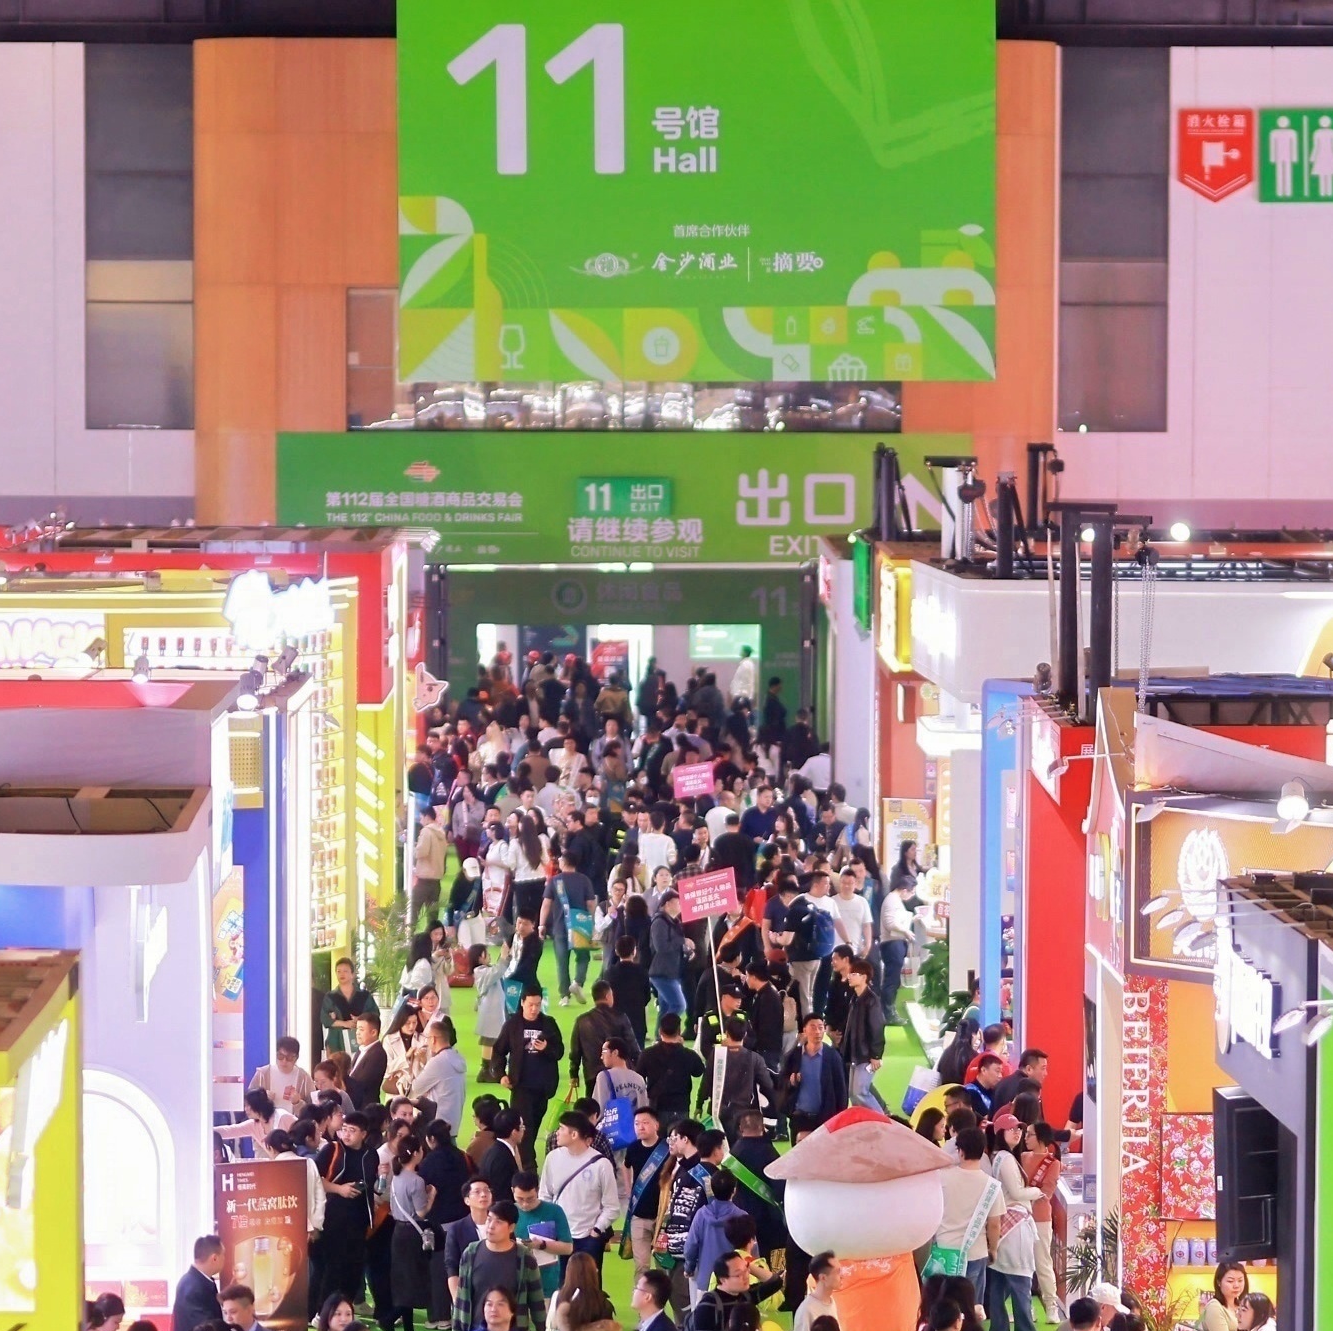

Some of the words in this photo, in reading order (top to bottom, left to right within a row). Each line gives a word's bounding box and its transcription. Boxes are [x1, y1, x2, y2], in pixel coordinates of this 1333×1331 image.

[447, 23, 625, 175] 11
[651, 106, 720, 141] 号馆
[653, 146, 718, 174] Hall
[673, 224, 750, 238] 首席合作伙伴
[584, 483, 611, 511] 11
[630, 484, 664, 500] 出口
[736, 468, 855, 525] 出口
[326, 513, 348, 522] THE
[374, 513, 409, 522] CHINA
[411, 513, 442, 522] FOOD
[454, 513, 495, 522] DRINKS
[498, 513, 523, 522] FAIR
[631, 502, 660, 512] EXIT
[568, 517, 703, 543] 请继续参观
[570, 545, 641, 558] CONTINUE
[645, 545, 663, 558] TO
[665, 545, 701, 558] VISIT
[1122, 991, 1151, 1177] BEIERJIA
[226, 1195, 298, 1214] 新一代燕窝肽饮
